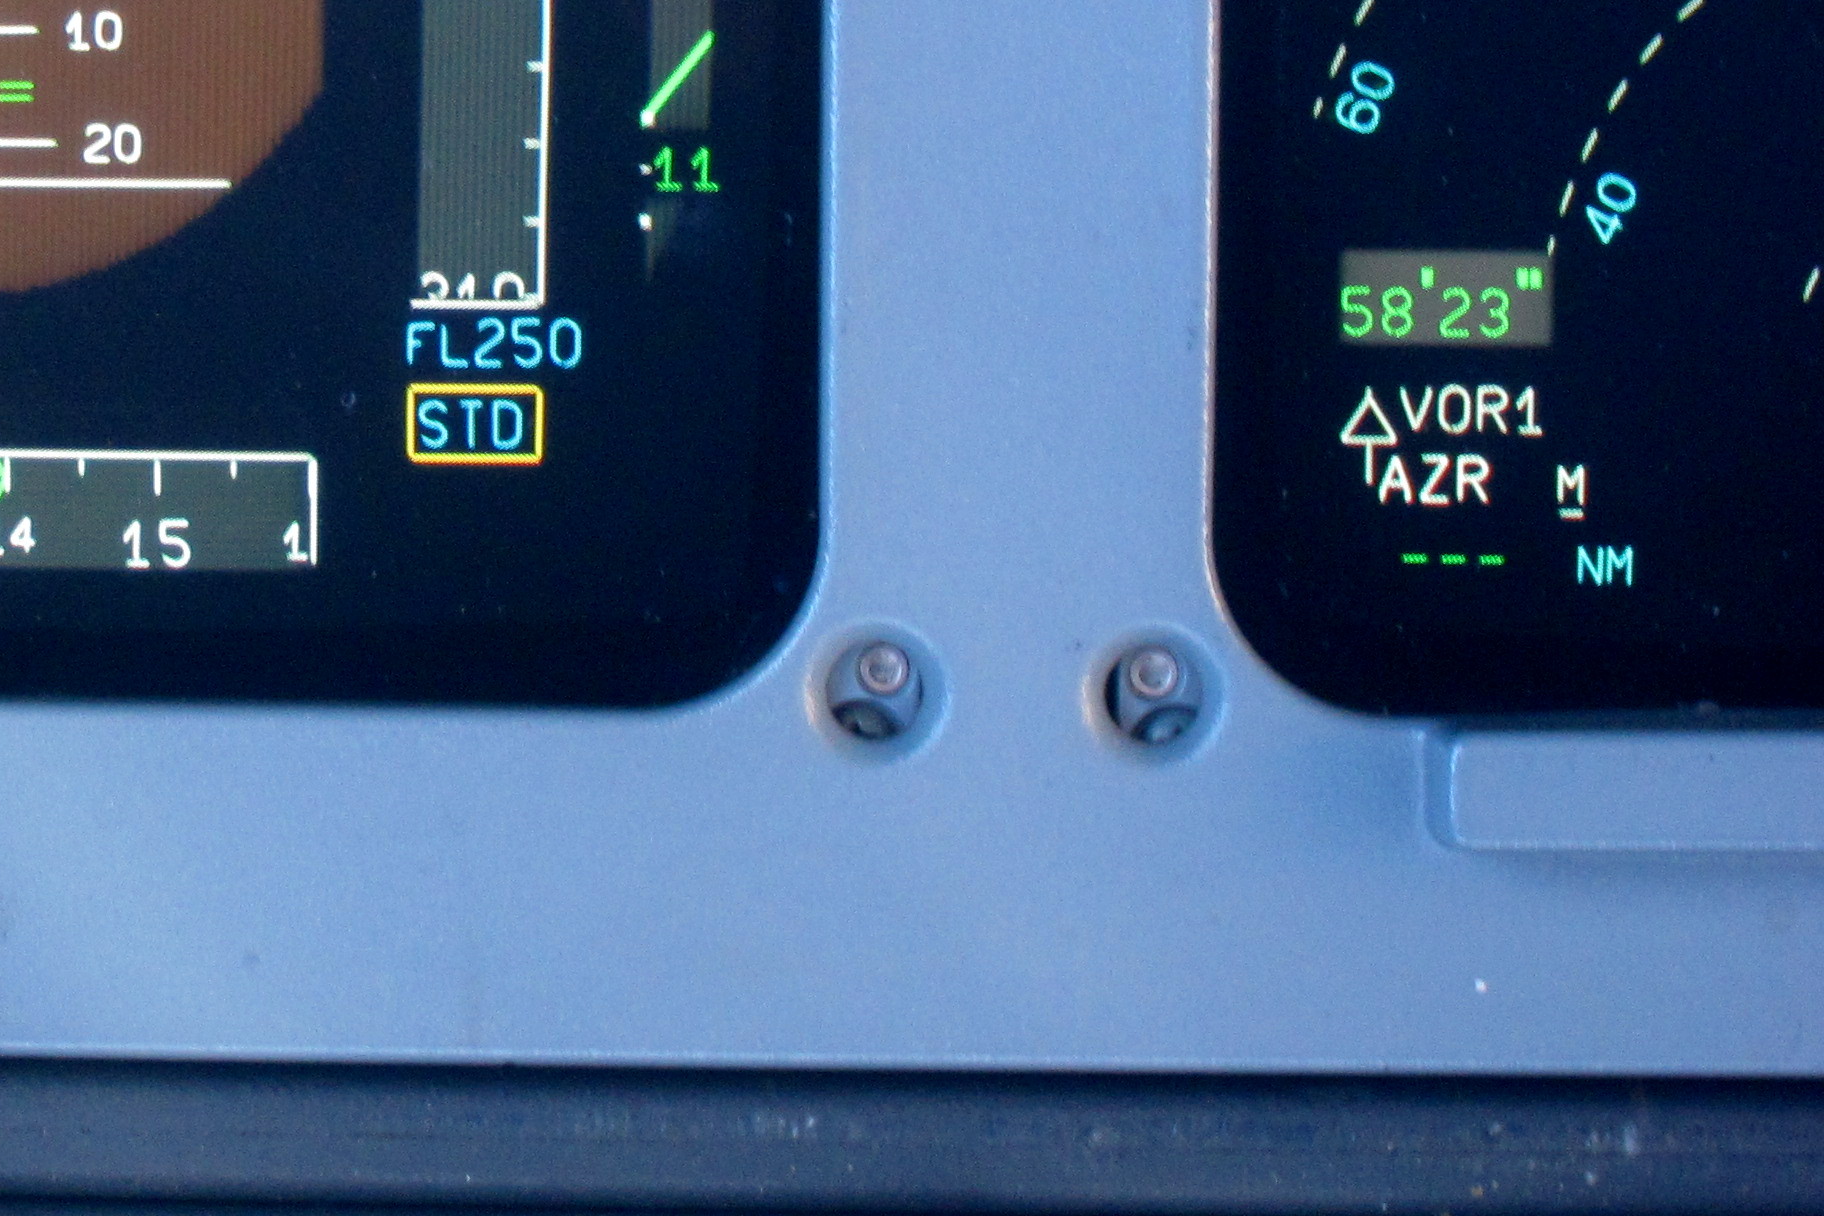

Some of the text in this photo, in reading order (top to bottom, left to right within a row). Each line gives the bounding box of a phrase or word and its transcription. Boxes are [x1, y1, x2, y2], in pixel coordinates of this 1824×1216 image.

[65, 10, 124, 52] 10
[1335, 59, 1396, 135] 60
[82, 122, 142, 165] 20
[653, 146, 720, 193] 11
[1585, 172, 1638, 245] 40
[406, 317, 582, 370] FL250
[417, 398, 524, 451] STD
[1398, 384, 1544, 437] VOR1
[1378, 454, 1492, 506] AZR
[122, 517, 191, 569] 15
[1576, 546, 1634, 588] NM
